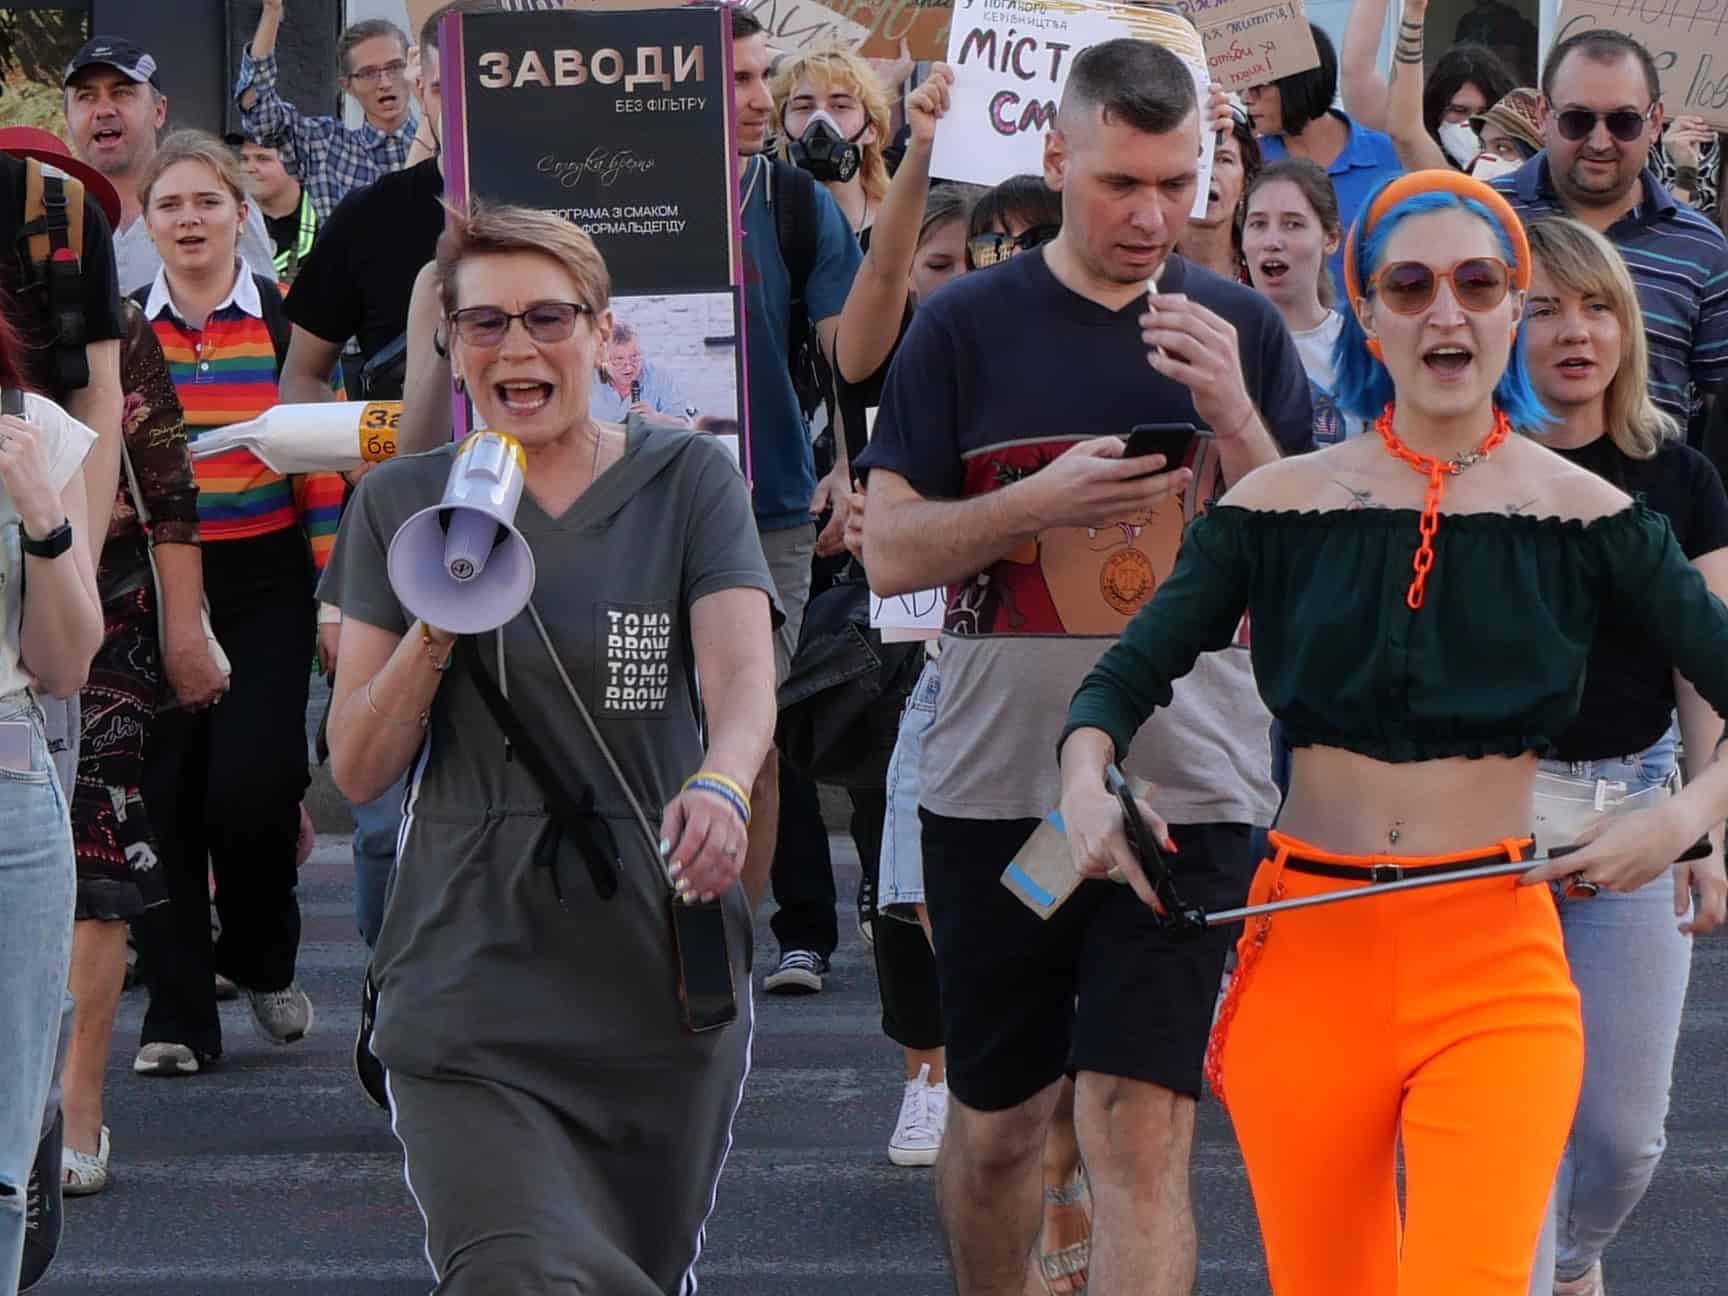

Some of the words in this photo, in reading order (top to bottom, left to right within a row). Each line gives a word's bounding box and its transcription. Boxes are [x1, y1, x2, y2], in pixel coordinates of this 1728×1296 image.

[478, 45, 705, 92] ЗАВОДИ
[615, 99, 642, 112] БЕЗ
[647, 97, 706, 111] ФІЛЬТРУ
[624, 205, 679, 218] СМАКОМ
[607, 610, 671, 637] TOMO
[607, 635, 670, 660] RROW
[607, 661, 669, 686] TOMO
[604, 686, 668, 710] RROW
